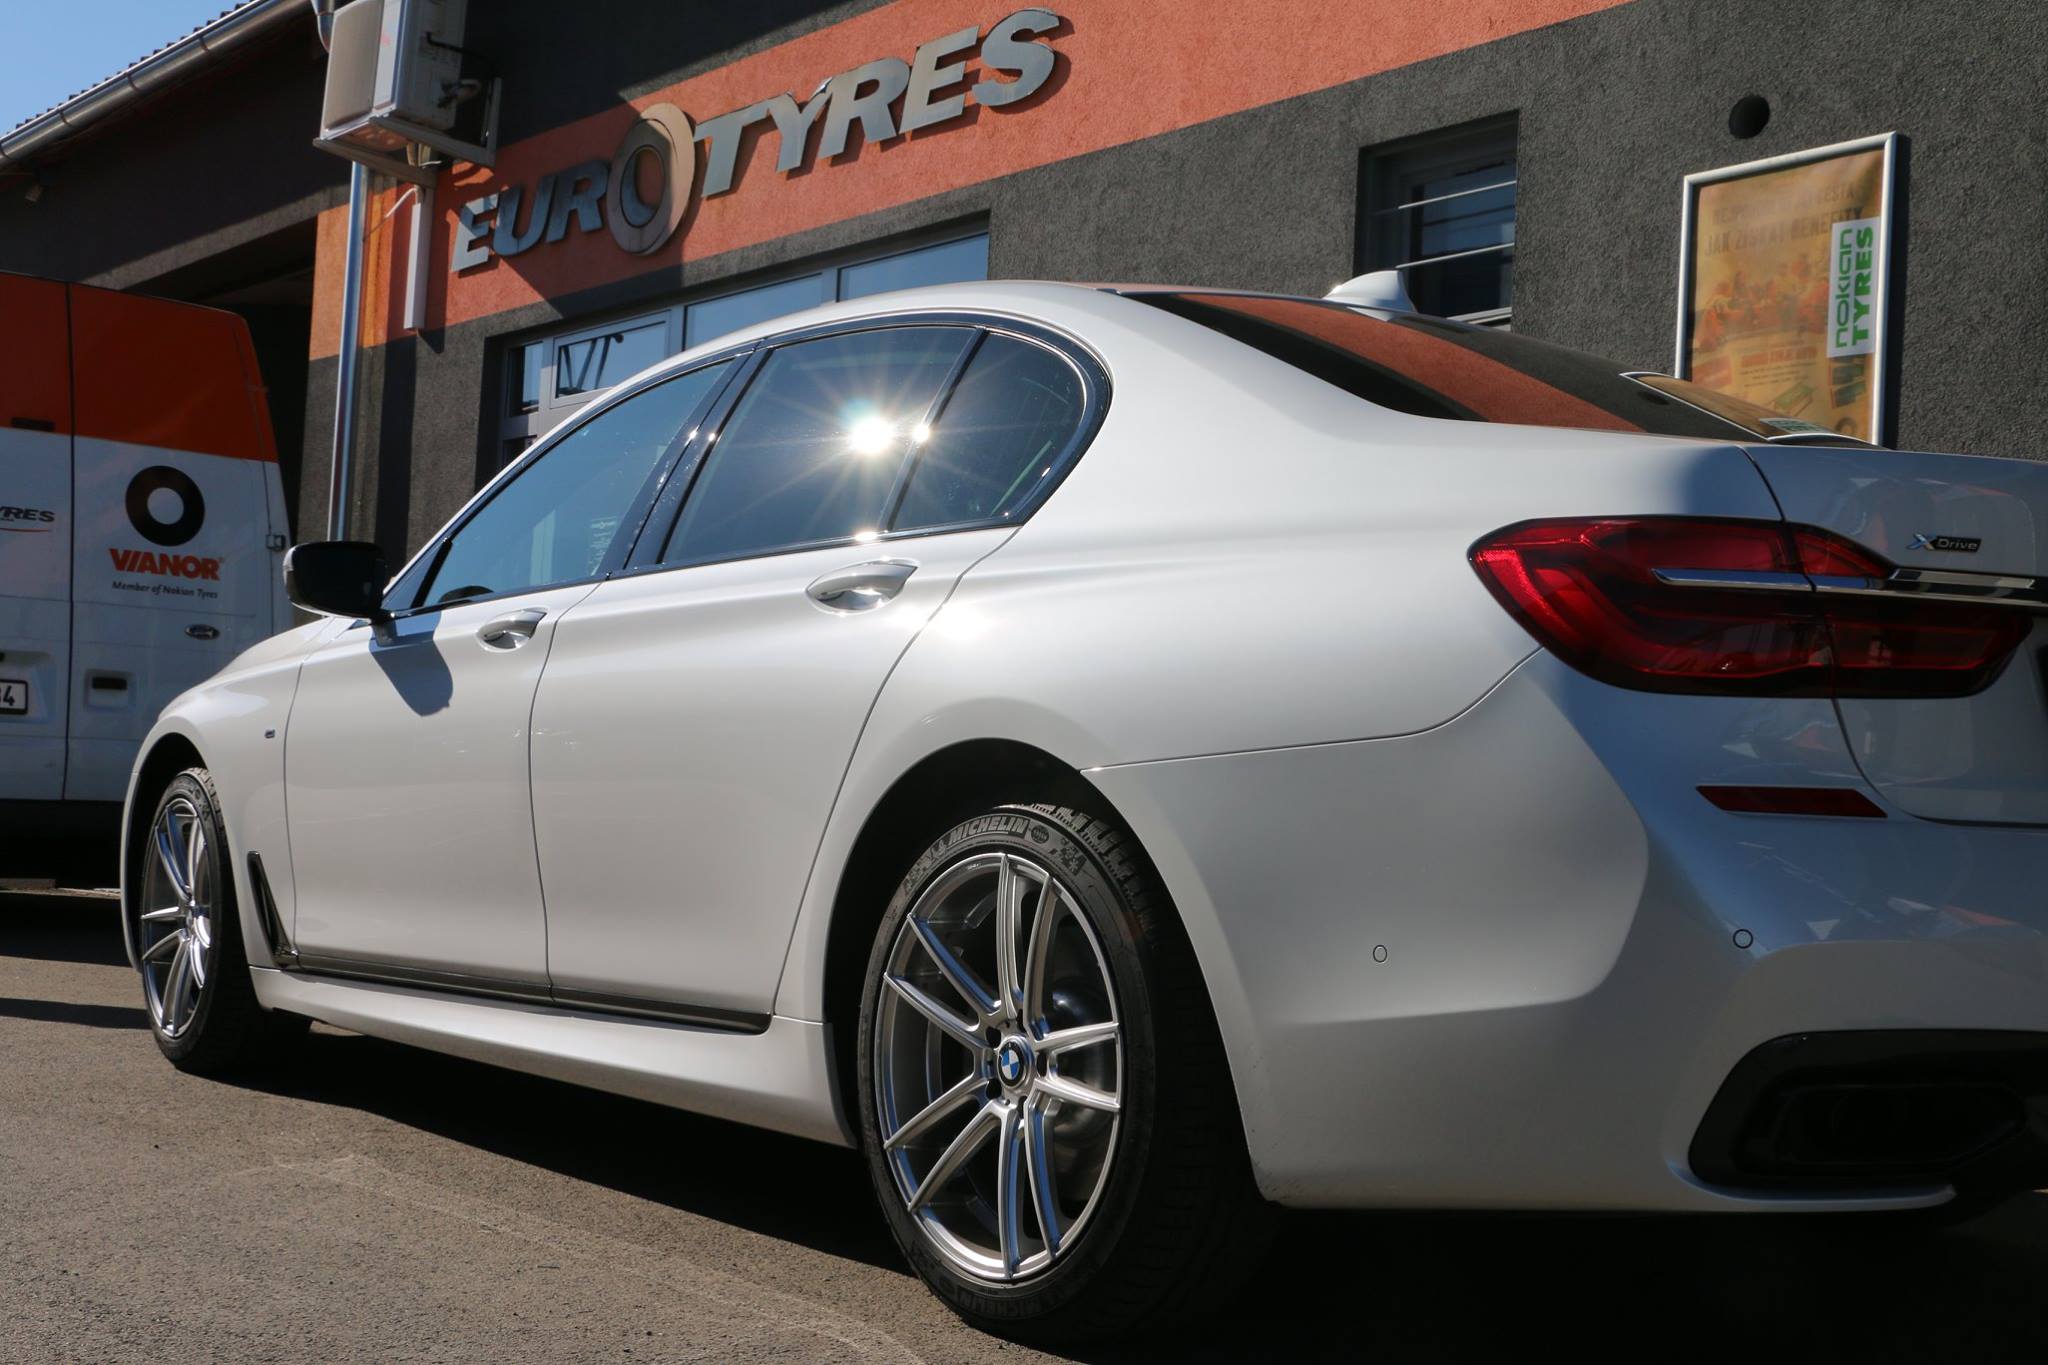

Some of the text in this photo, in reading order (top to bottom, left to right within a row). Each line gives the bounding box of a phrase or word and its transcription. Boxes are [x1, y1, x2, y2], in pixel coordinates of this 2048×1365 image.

[451, 8, 1063, 273] EUROTYRES
[1835, 228, 1853, 349] nokian
[1852, 226, 1874, 346] TYRES
[109, 548, 221, 581] VIANOR
[112, 581, 218, 600] Member of Nokian Tyres
[0, 684, 16, 706] 4
[948, 815, 1029, 844] MICHELIN
